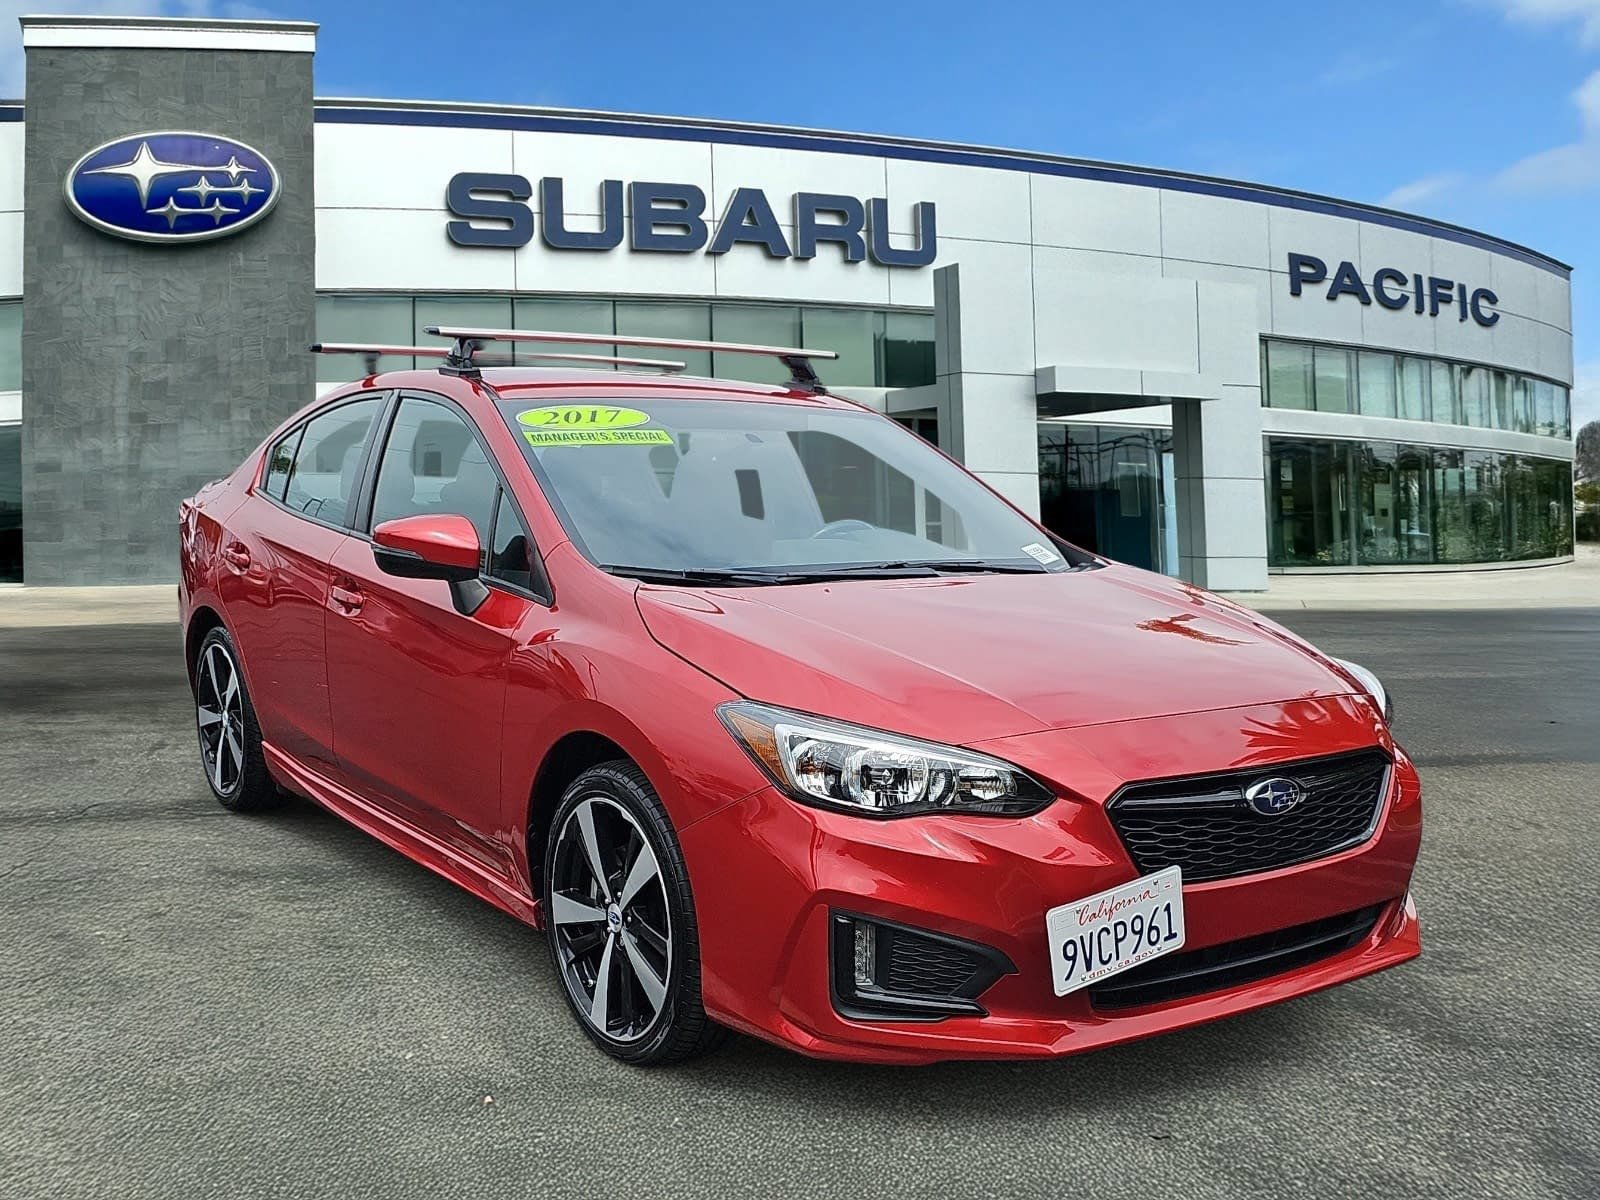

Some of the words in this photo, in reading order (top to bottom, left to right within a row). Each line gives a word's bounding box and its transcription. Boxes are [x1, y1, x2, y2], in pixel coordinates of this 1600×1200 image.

[447, 172, 937, 267] SUBARU
[1288, 252, 1500, 327] PACIFIC
[543, 409, 622, 425] 2017
[531, 431, 608, 443] MANAGER'S
[613, 430, 664, 441] SPECIAL
[1077, 888, 1157, 926] California
[1062, 902, 1178, 982] 9VCP961
[1088, 950, 1155, 979] dmv.ca.gov
